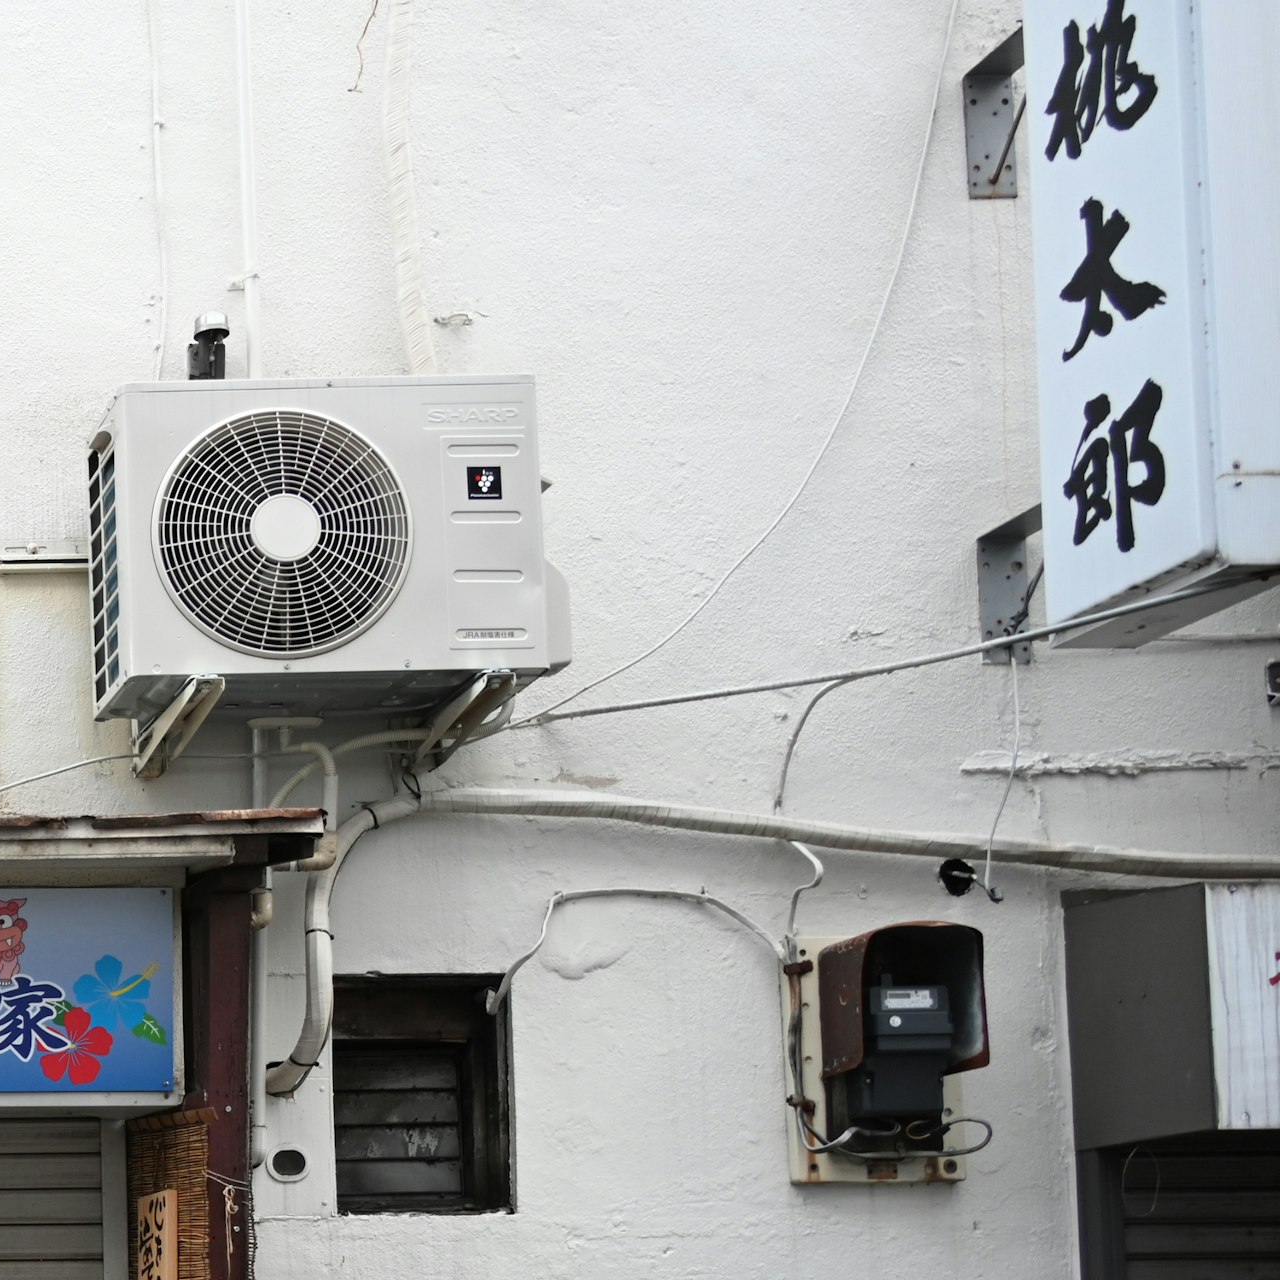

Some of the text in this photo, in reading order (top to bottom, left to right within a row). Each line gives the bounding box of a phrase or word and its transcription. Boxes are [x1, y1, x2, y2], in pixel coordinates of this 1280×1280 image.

[427, 407, 519, 423] SHARP
[1045, 0, 1168, 553] 桃太郎
